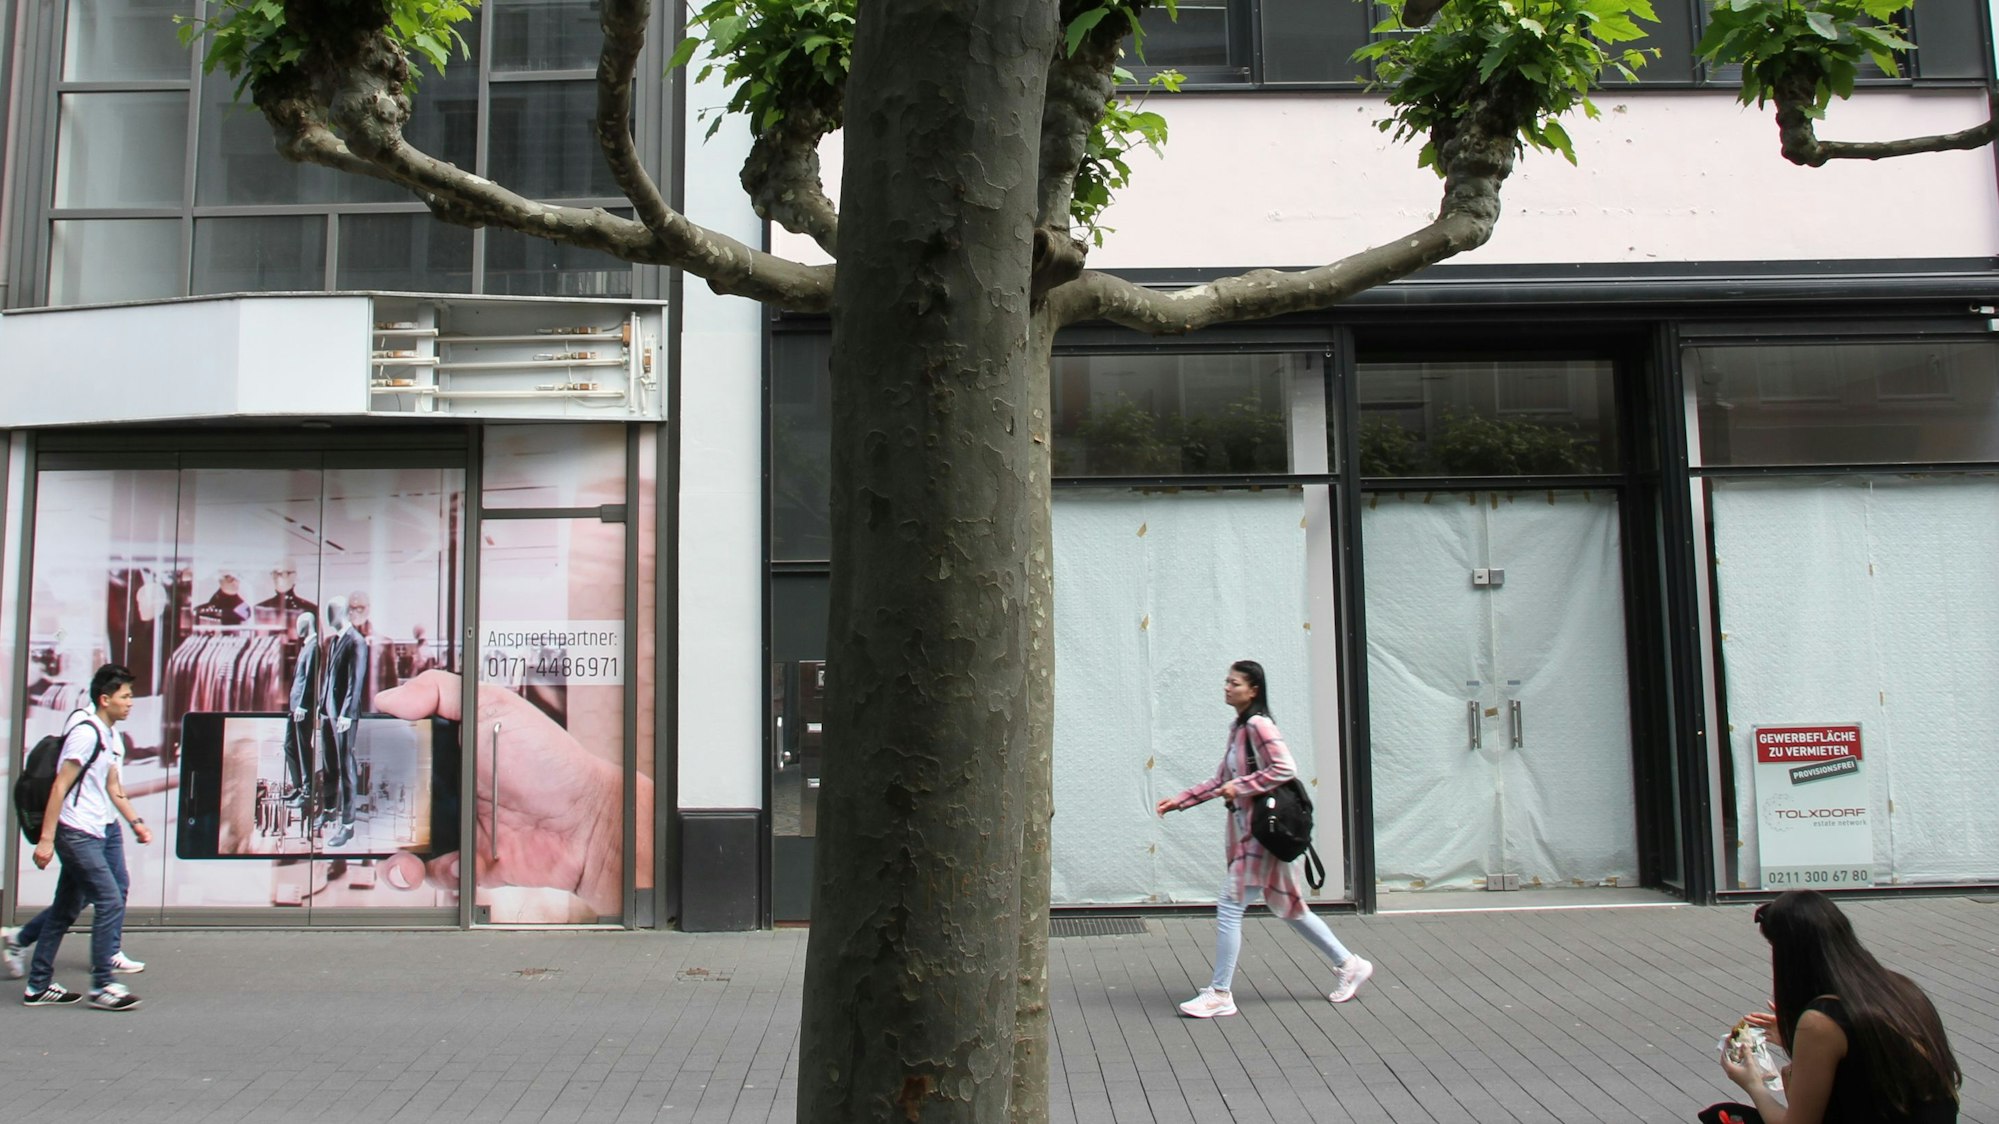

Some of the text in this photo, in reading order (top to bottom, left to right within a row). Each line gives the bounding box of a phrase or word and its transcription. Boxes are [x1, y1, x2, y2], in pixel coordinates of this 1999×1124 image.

[487, 630, 618, 649] Ansprechpartner:
[487, 657, 617, 678] 0171-4486971
[1759, 729, 1857, 744] GEWERBEFLÄCHE
[1768, 745, 1849, 757] ZU VERMIETEN
[1793, 761, 1855, 779] PROVISIONSFREI
[1775, 808, 1866, 819] TOLXDORF
[1837, 819, 1867, 827] network
[1768, 869, 1868, 884] 0211 300 67 80
